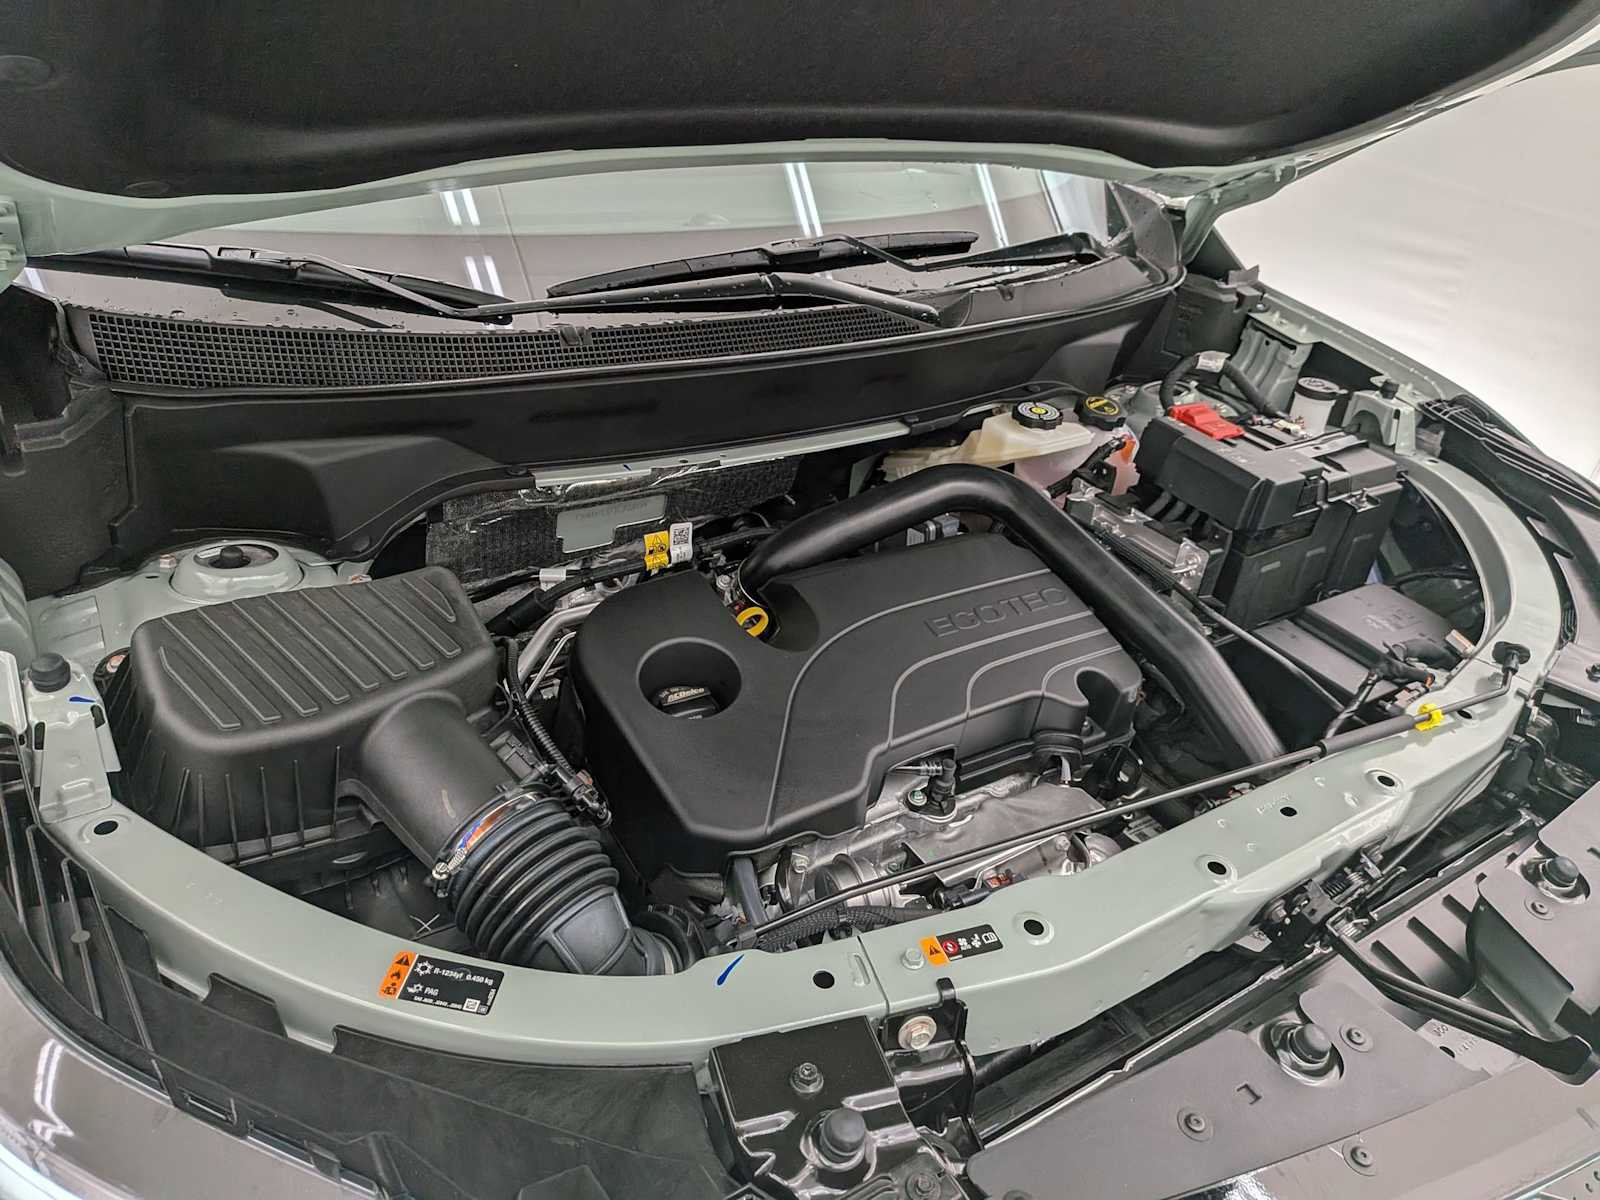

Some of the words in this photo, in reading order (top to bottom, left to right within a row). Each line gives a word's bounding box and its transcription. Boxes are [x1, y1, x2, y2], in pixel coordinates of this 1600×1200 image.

[923, 587, 1070, 638] ECOTEC
[667, 687, 705, 703] ACDelco
[466, 973, 484, 982] 0.450
[485, 976, 493, 985] kg
[424, 987, 438, 996] PAG
